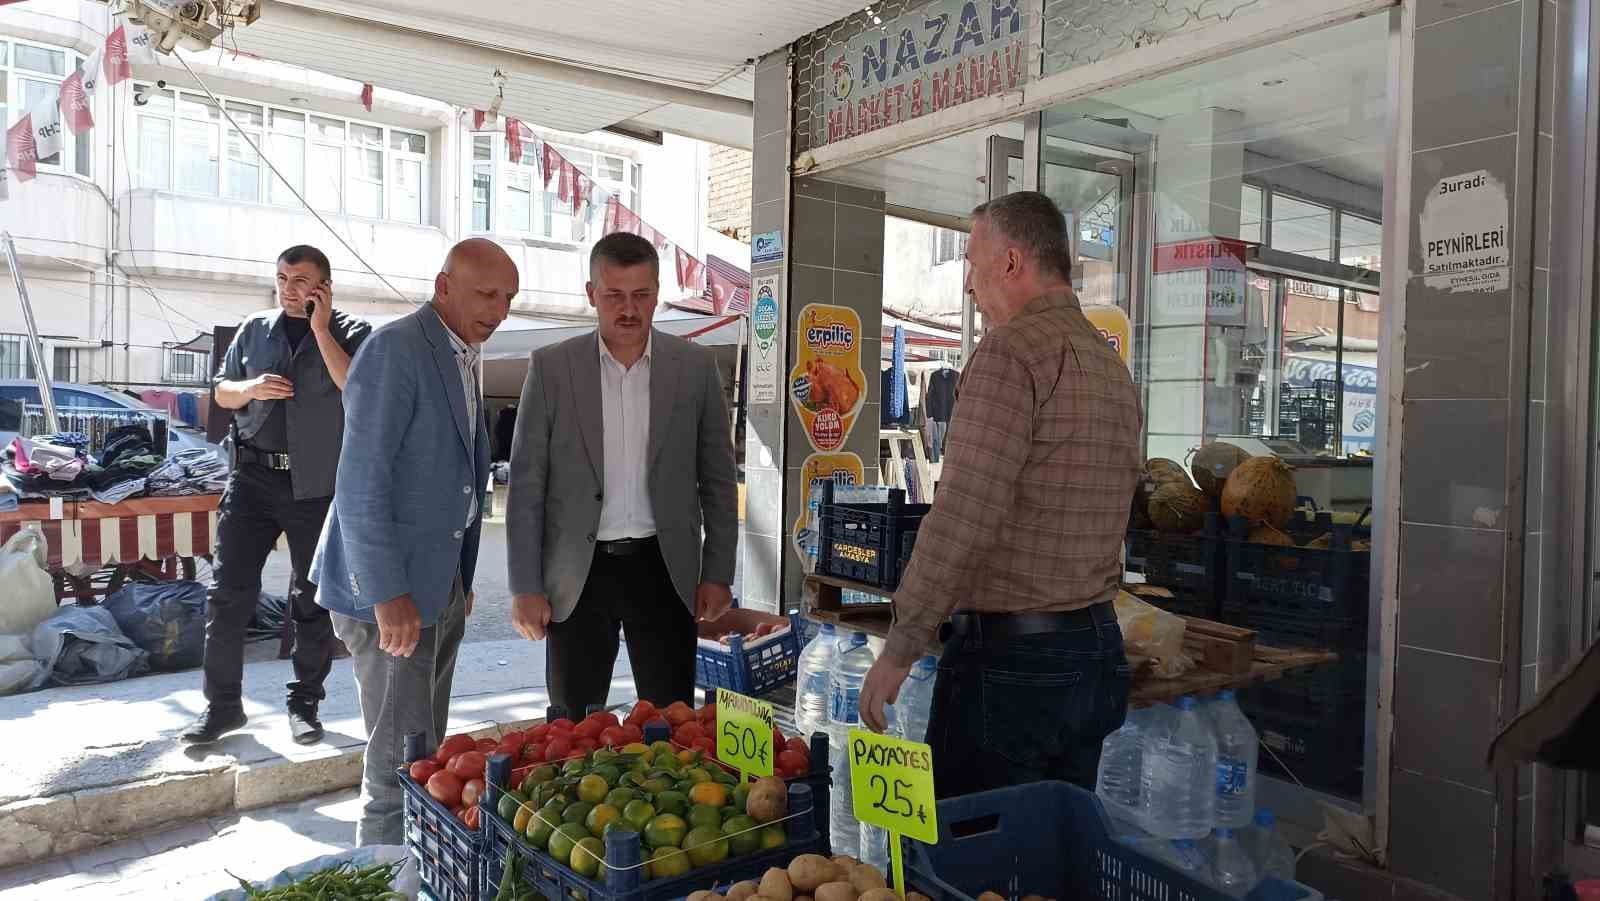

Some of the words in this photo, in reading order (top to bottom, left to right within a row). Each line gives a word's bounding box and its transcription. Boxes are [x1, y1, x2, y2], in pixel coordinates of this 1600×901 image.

[827, 84, 905, 145] MARKET
[932, 40, 1023, 113] MANAV
[1427, 224, 1504, 258] PEYNİRLERİ
[1428, 255, 1505, 273] Satılmaktadır.
[807, 322, 854, 350] erpiliç
